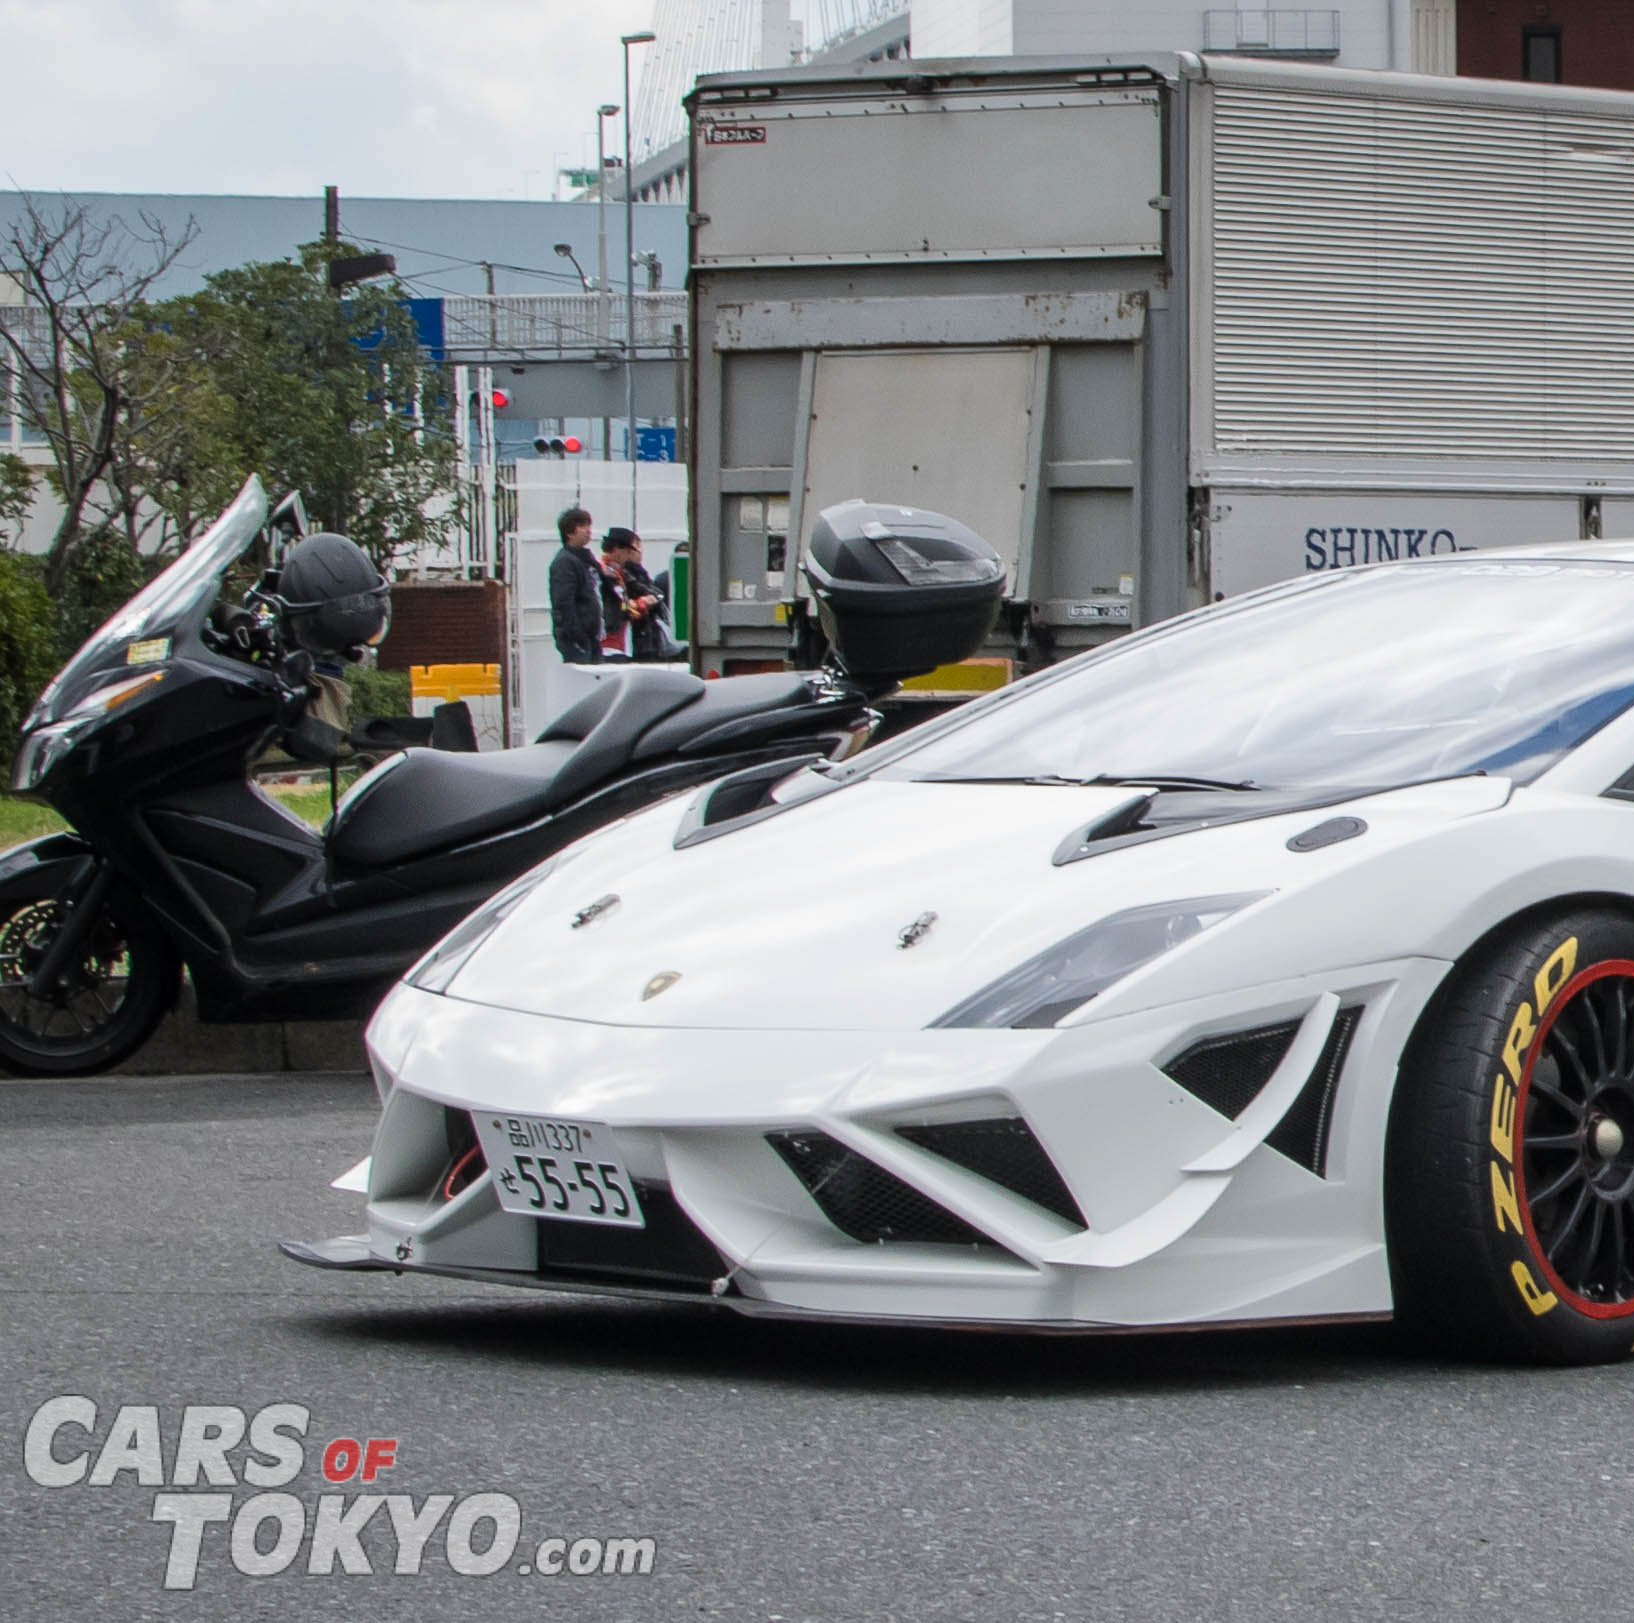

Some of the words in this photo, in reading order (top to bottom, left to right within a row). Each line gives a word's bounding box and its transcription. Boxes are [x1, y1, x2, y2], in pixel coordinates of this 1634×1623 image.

[1490, 936, 1578, 1236] ZERO
[500, 1167, 520, 1194] せ
[513, 1154, 630, 1217] 55-55
[1511, 1260, 1557, 1316] P
